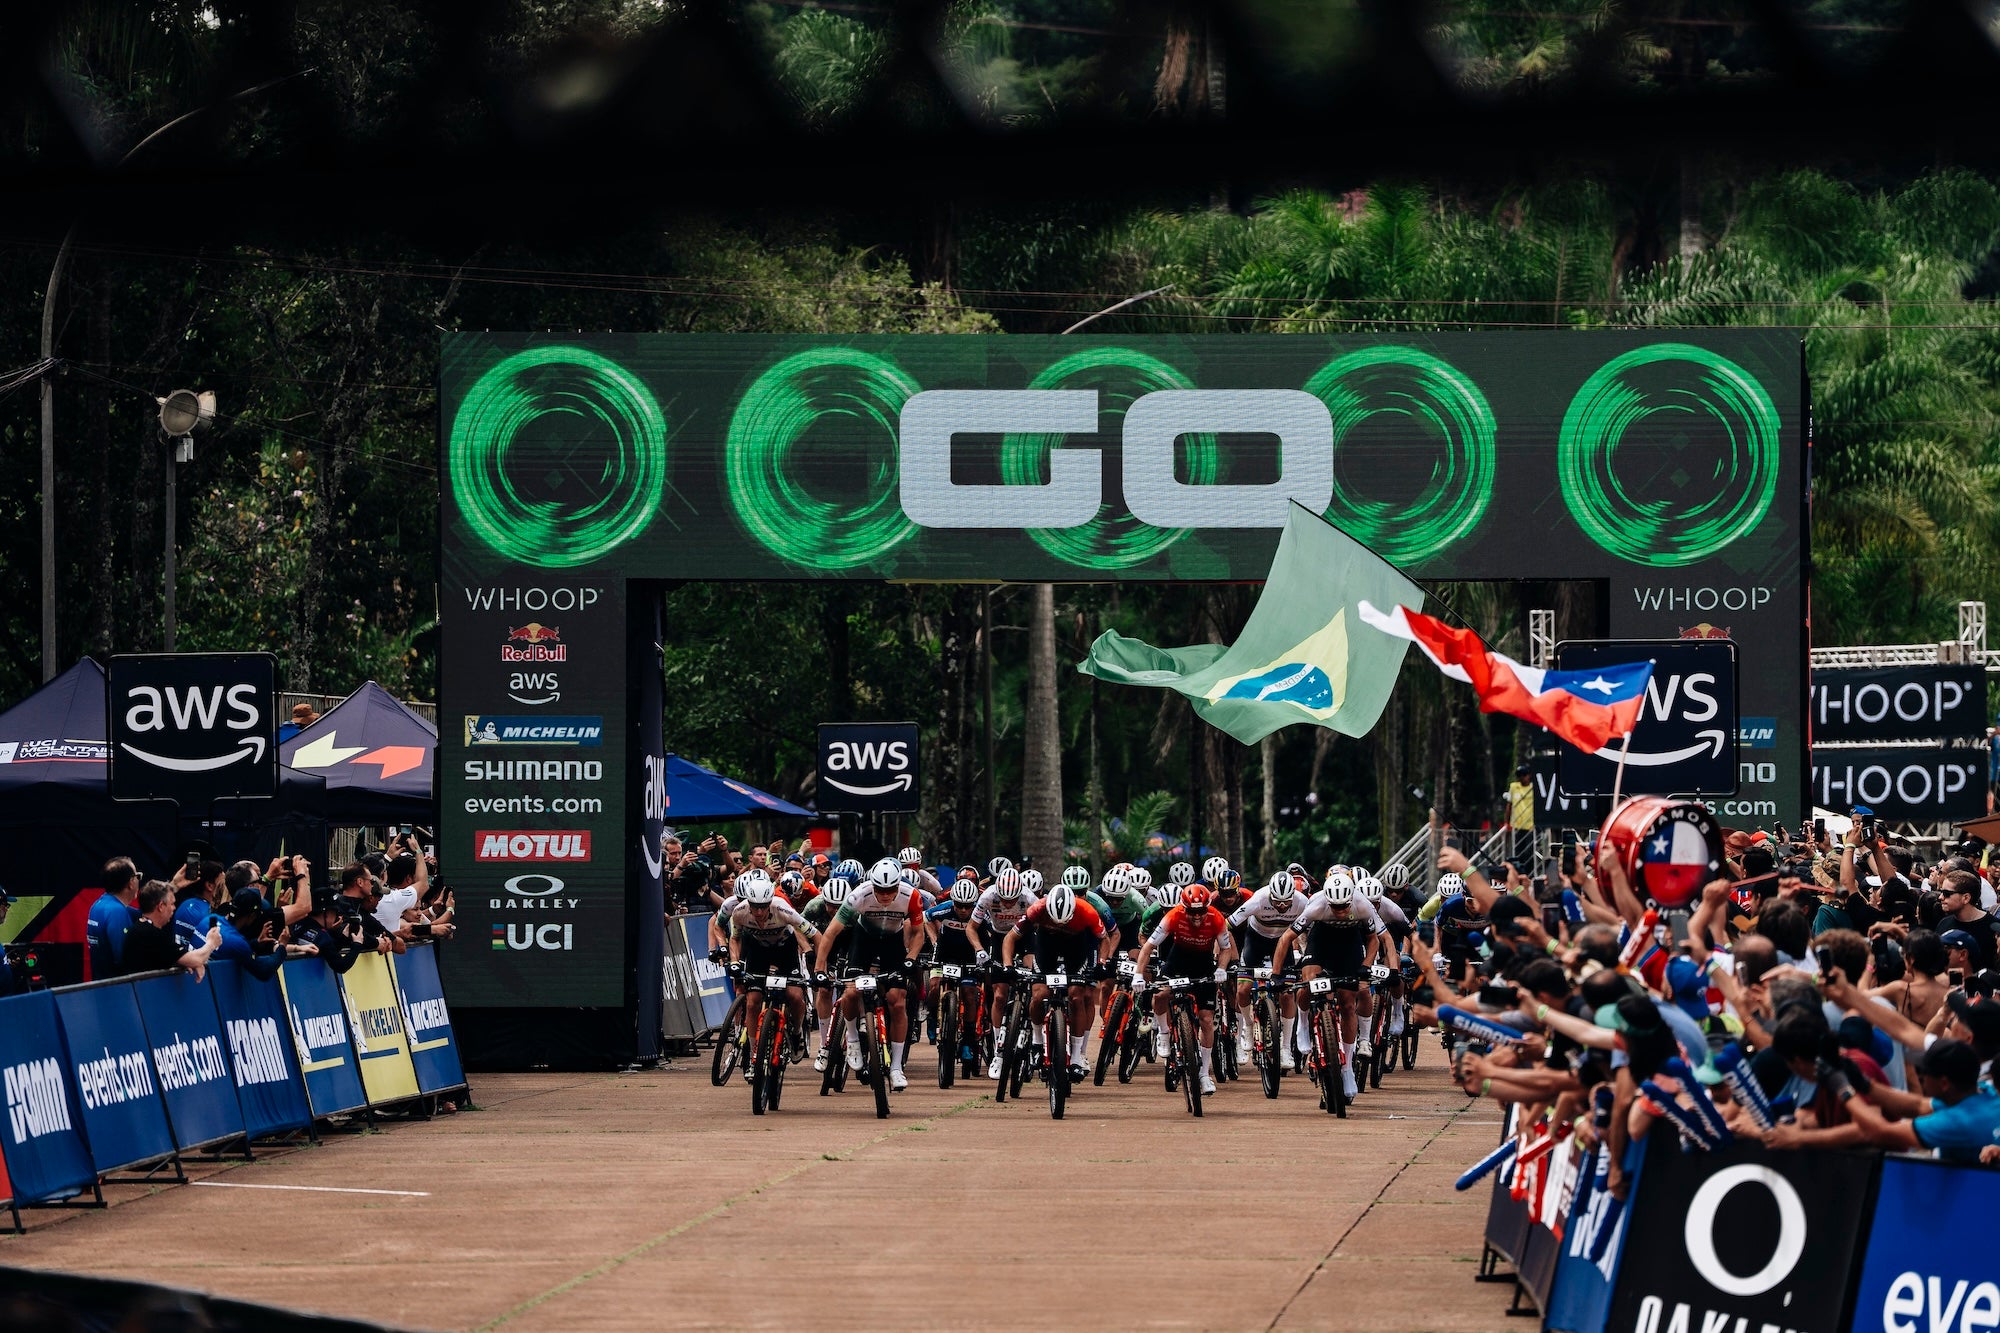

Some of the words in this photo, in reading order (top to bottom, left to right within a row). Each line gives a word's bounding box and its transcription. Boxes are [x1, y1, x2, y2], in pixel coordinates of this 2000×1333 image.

[899, 388, 1334, 528] GO
[465, 587, 602, 611] WHOOP
[1634, 587, 1774, 611] WHOOP
[502, 644, 534, 661] Red
[535, 644, 567, 661] Bull
[509, 672, 559, 690] aws
[125, 683, 259, 733] aws
[1636, 672, 1719, 722] ws
[1811, 681, 1972, 725] HOOP
[29, 739, 57, 747] UCI
[502, 726, 600, 738] MICHELIN
[827, 741, 909, 771] aws
[464, 760, 603, 781] SHIMANO
[1812, 764, 1976, 805] HOOP
[464, 794, 602, 813] events.com
[480, 834, 586, 857] MOTUL
[489, 899, 579, 909] OAKLEY
[507, 923, 573, 951] UCI
[946, 967, 958, 975] 27
[1123, 963, 1135, 972] 21
[1375, 969, 1386, 977] 10
[1314, 981, 1327, 990] 13
[360, 1006, 401, 1038] MICHELIN
[410, 998, 450, 1031] MICHELIN
[304, 1013, 346, 1049] MICHELIN
[153, 1032, 227, 1092] events.com
[78, 1046, 154, 1110] events.com
